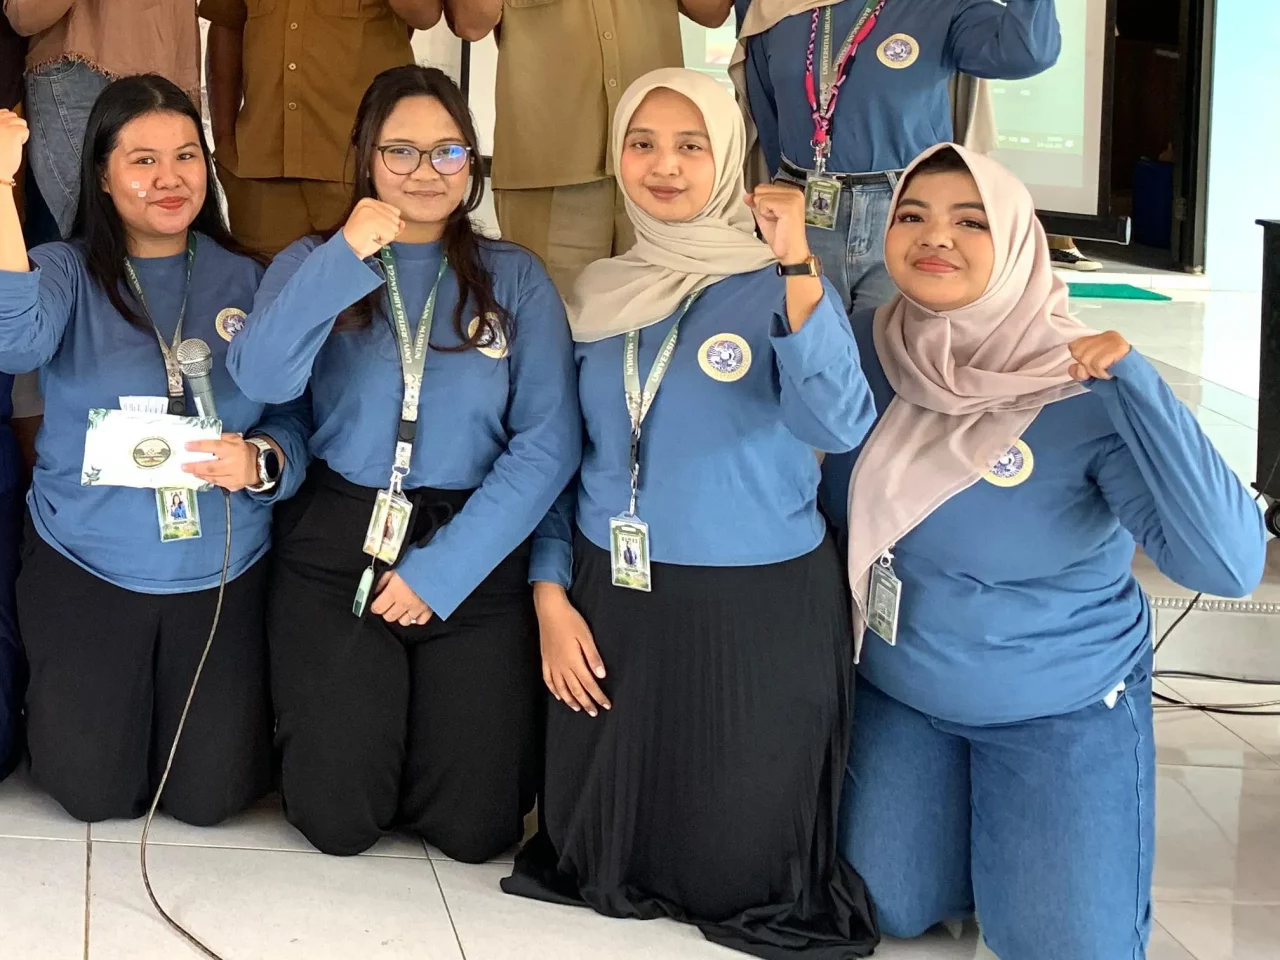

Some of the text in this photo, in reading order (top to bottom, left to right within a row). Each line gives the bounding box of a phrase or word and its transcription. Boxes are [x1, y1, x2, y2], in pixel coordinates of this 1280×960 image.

[387, 264, 413, 364] UNIVERSITAS AIRLANGGA
[414, 325, 427, 360] MADIUN
[626, 341, 635, 376] MADIUN
